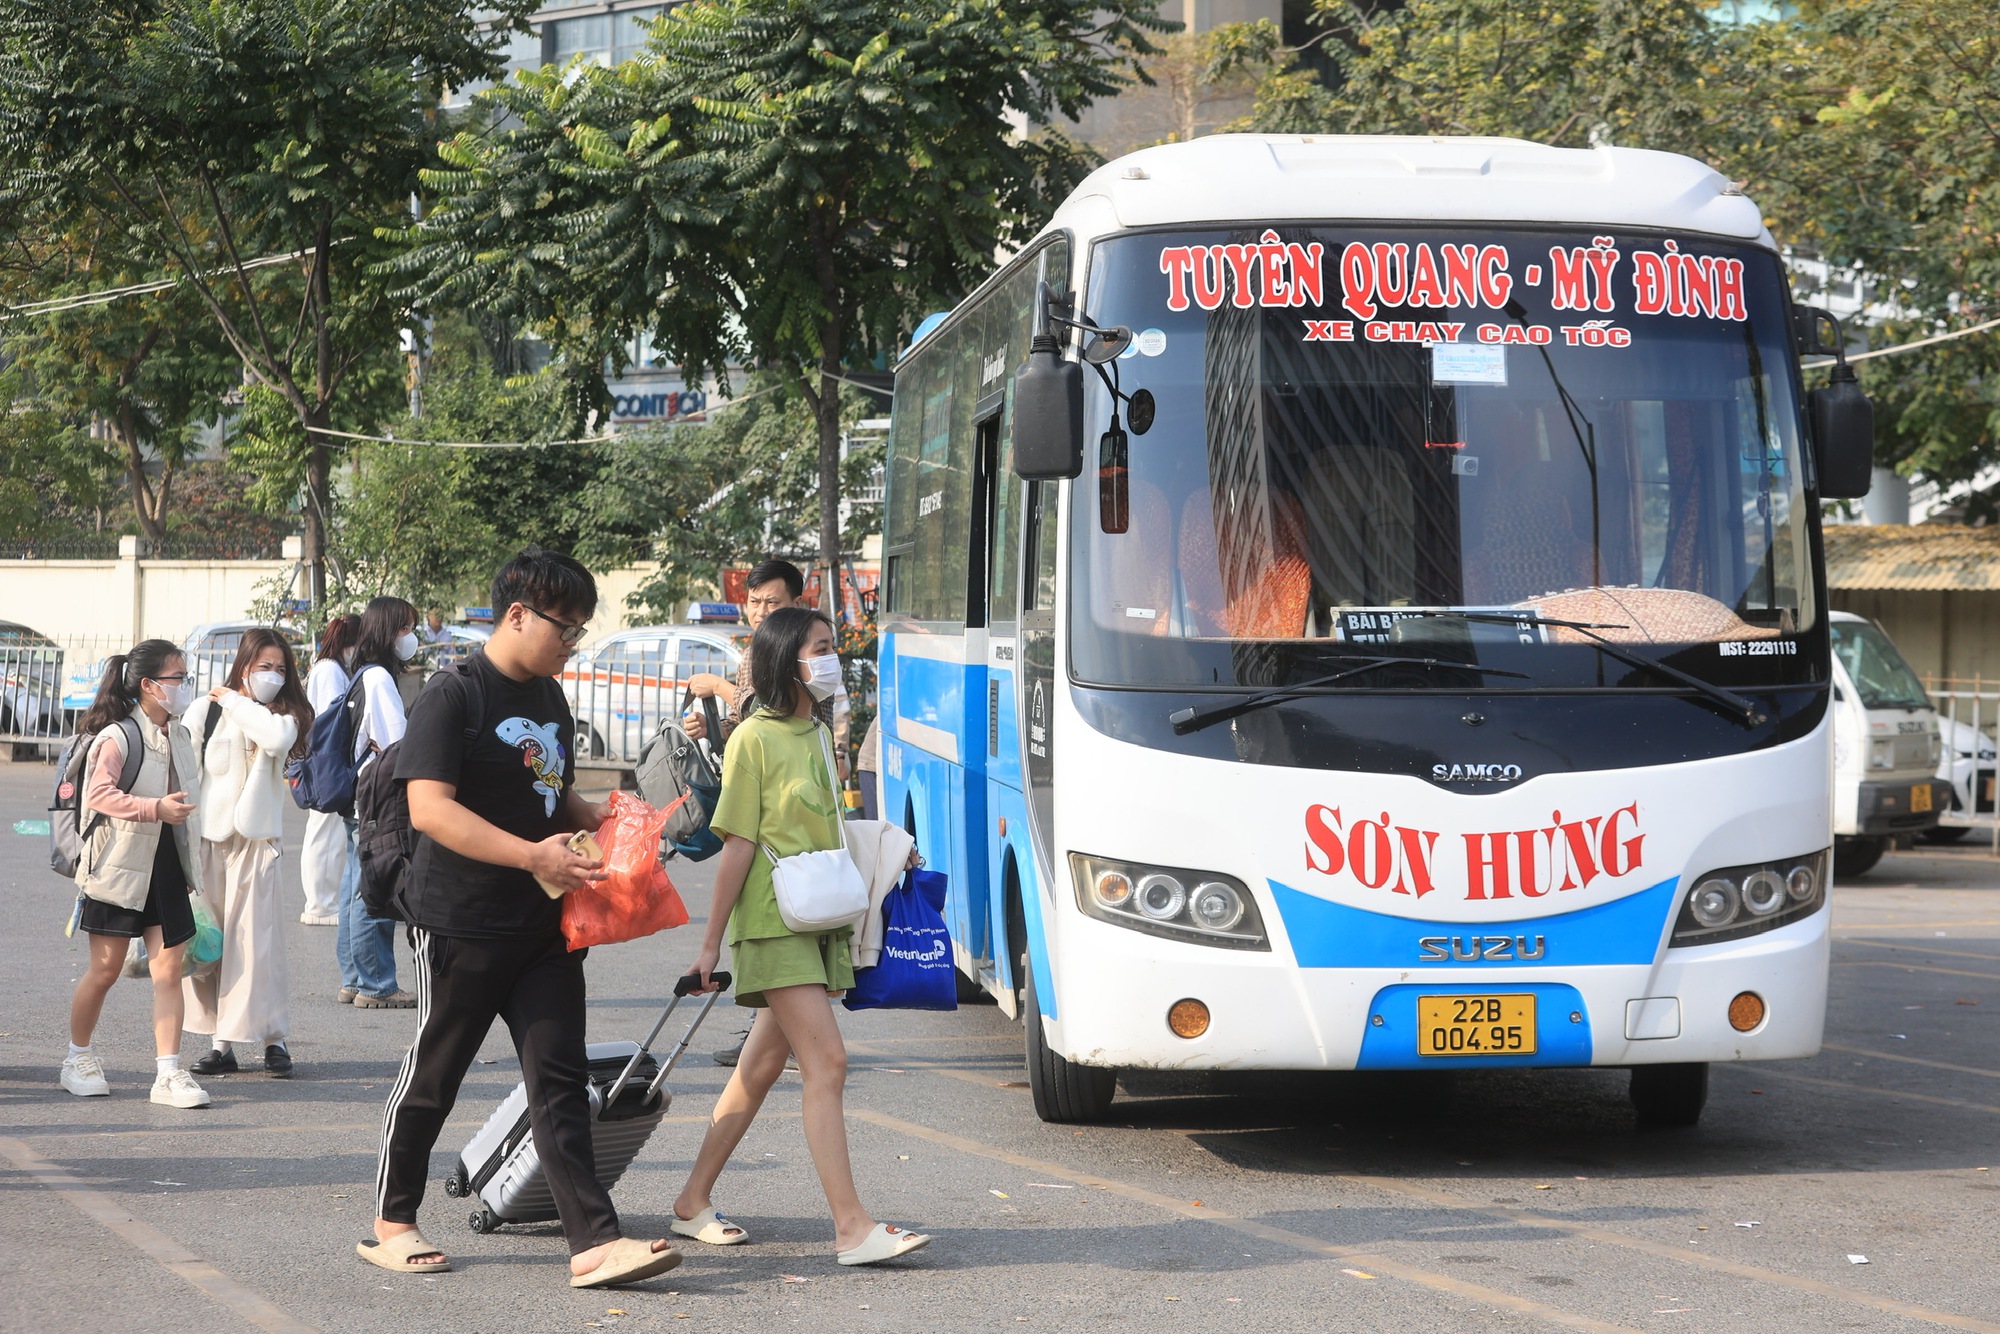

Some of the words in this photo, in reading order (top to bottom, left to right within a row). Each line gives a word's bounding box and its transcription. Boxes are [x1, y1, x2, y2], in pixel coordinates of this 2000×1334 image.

[1160, 229, 1324, 311] TUYÊN
[1340, 241, 1513, 321] QUANG
[1550, 236, 1620, 312] MỸ
[1632, 239, 1747, 321] ĐÌNH
[1302, 320, 1354, 342] XE
[1477, 323, 1552, 345] CAO
[1561, 320, 1631, 347] TỐC
[1347, 612, 1377, 629] BÃI
[1719, 642, 1746, 656] MST:
[1748, 641, 1797, 655] 22291113
[1432, 764, 1522, 781] SAMCO
[1304, 803, 1440, 899] SƠN
[1461, 799, 1646, 900] HƯNG
[1452, 999, 1501, 1022] 22B
[1432, 1026, 1522, 1051] 004.95
